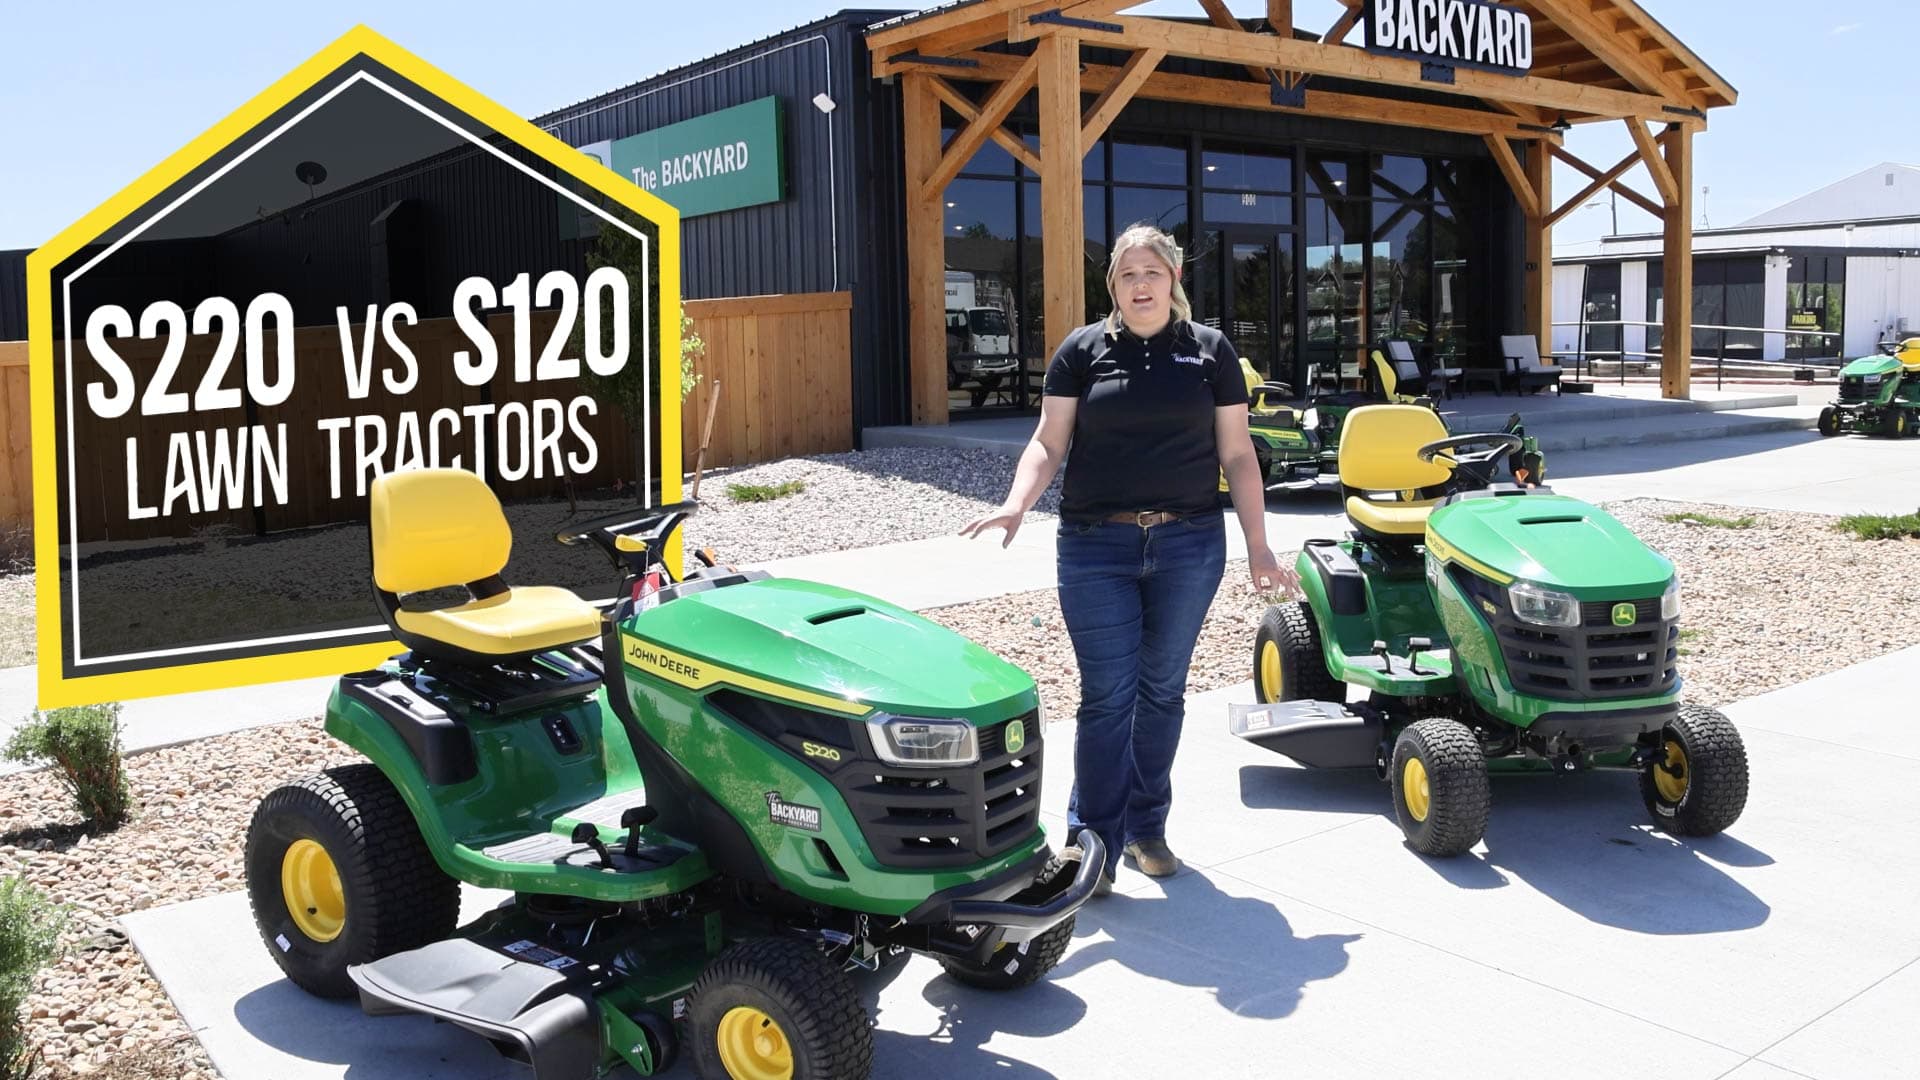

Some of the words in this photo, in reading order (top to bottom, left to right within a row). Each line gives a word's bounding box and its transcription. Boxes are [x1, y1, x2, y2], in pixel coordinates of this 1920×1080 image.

[1374, 0, 1532, 70] BACKYARD
[631, 167, 657, 191] The
[661, 141, 749, 188] BACKYARD
[629, 643, 658, 666] JOHN
[659, 654, 701, 681] DEERE
[802, 741, 841, 761] S220
[770, 802, 819, 824] BACKYARD
